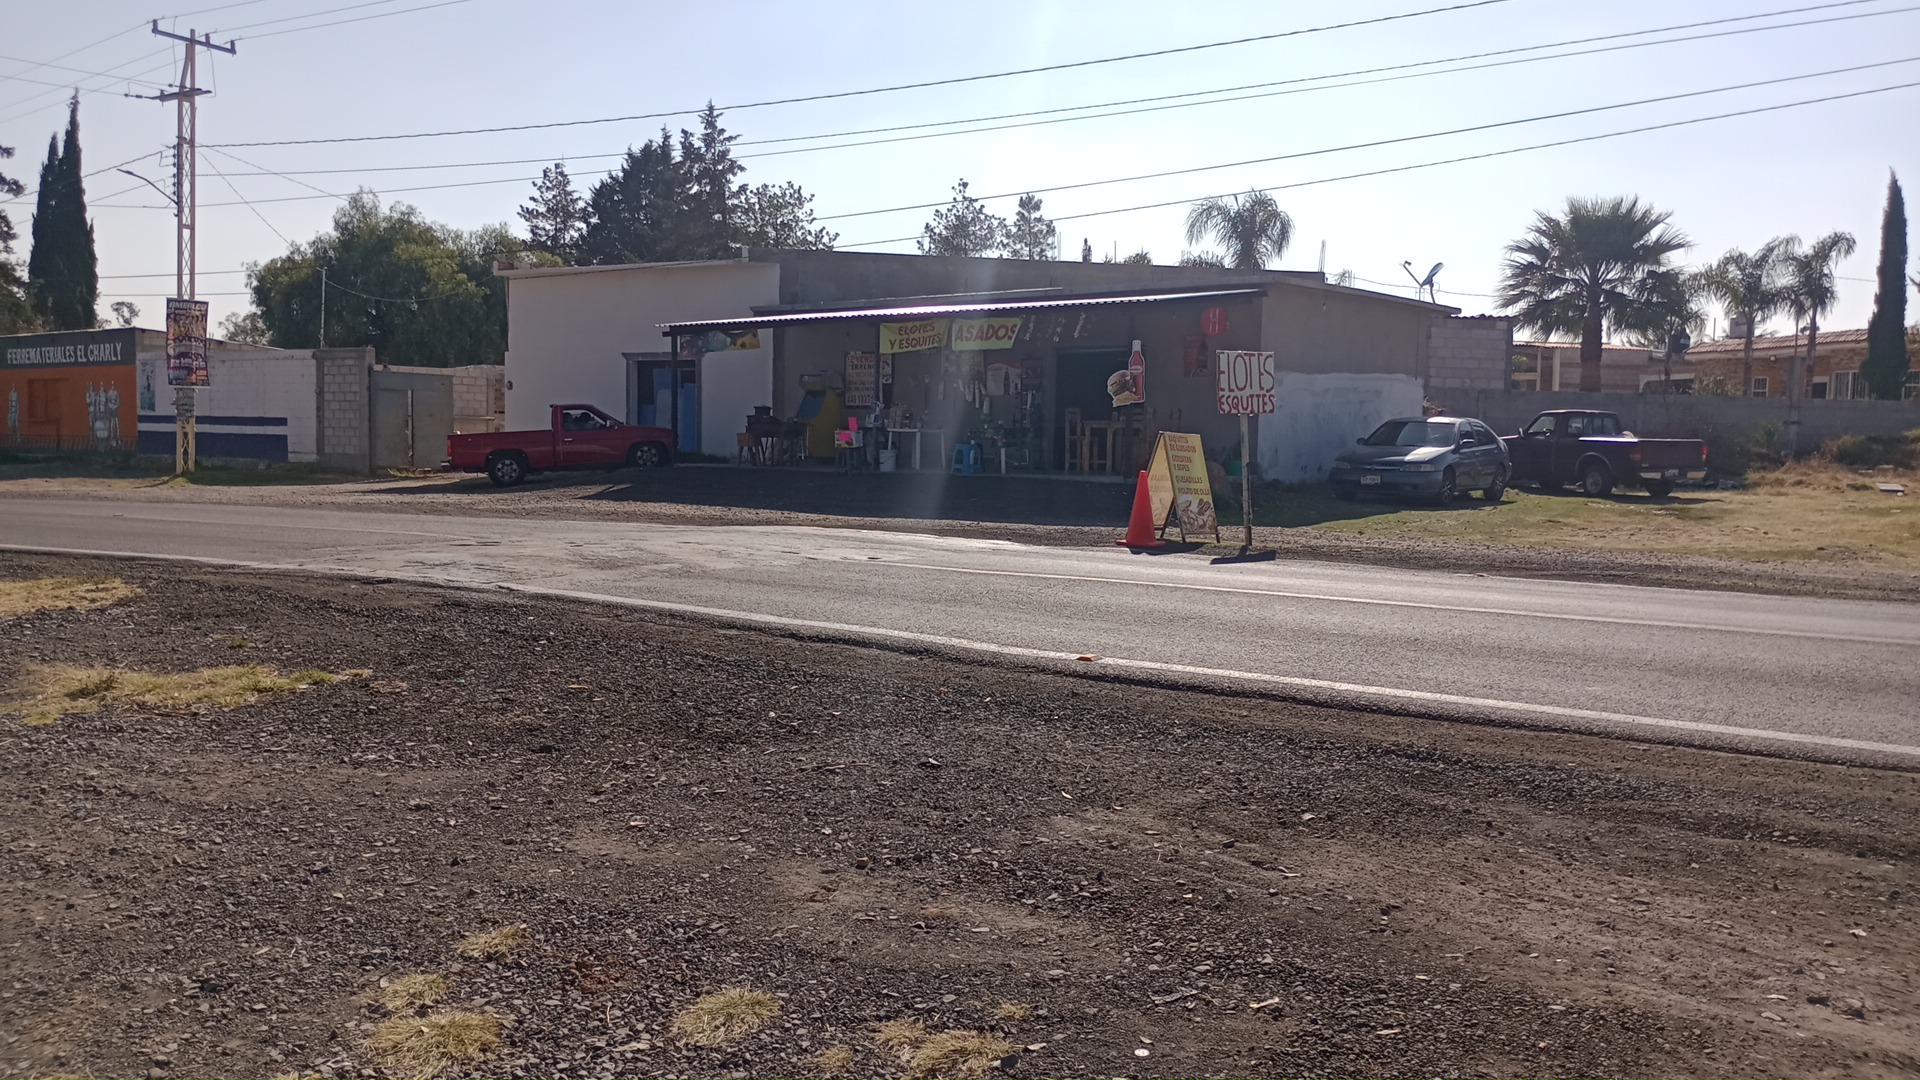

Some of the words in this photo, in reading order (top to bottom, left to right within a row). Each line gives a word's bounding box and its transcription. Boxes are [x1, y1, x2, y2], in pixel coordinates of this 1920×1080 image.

[897, 322, 936, 336] ELOTES
[955, 323, 1018, 343] ASADOS
[889, 339, 897, 351] Y
[899, 332, 942, 350] ESQUITES
[7, 345, 76, 365] FERREMATERIALES
[76, 344, 88, 363] EL
[87, 342, 122, 362] CHARLY
[1216, 351, 1275, 394] ELOTES
[1217, 393, 1276, 414] ESQUITES
[1169, 444, 1176, 452] DE
[1176, 464, 1190, 472] SOPES
[1175, 475, 1203, 484] QUESADILLAS
